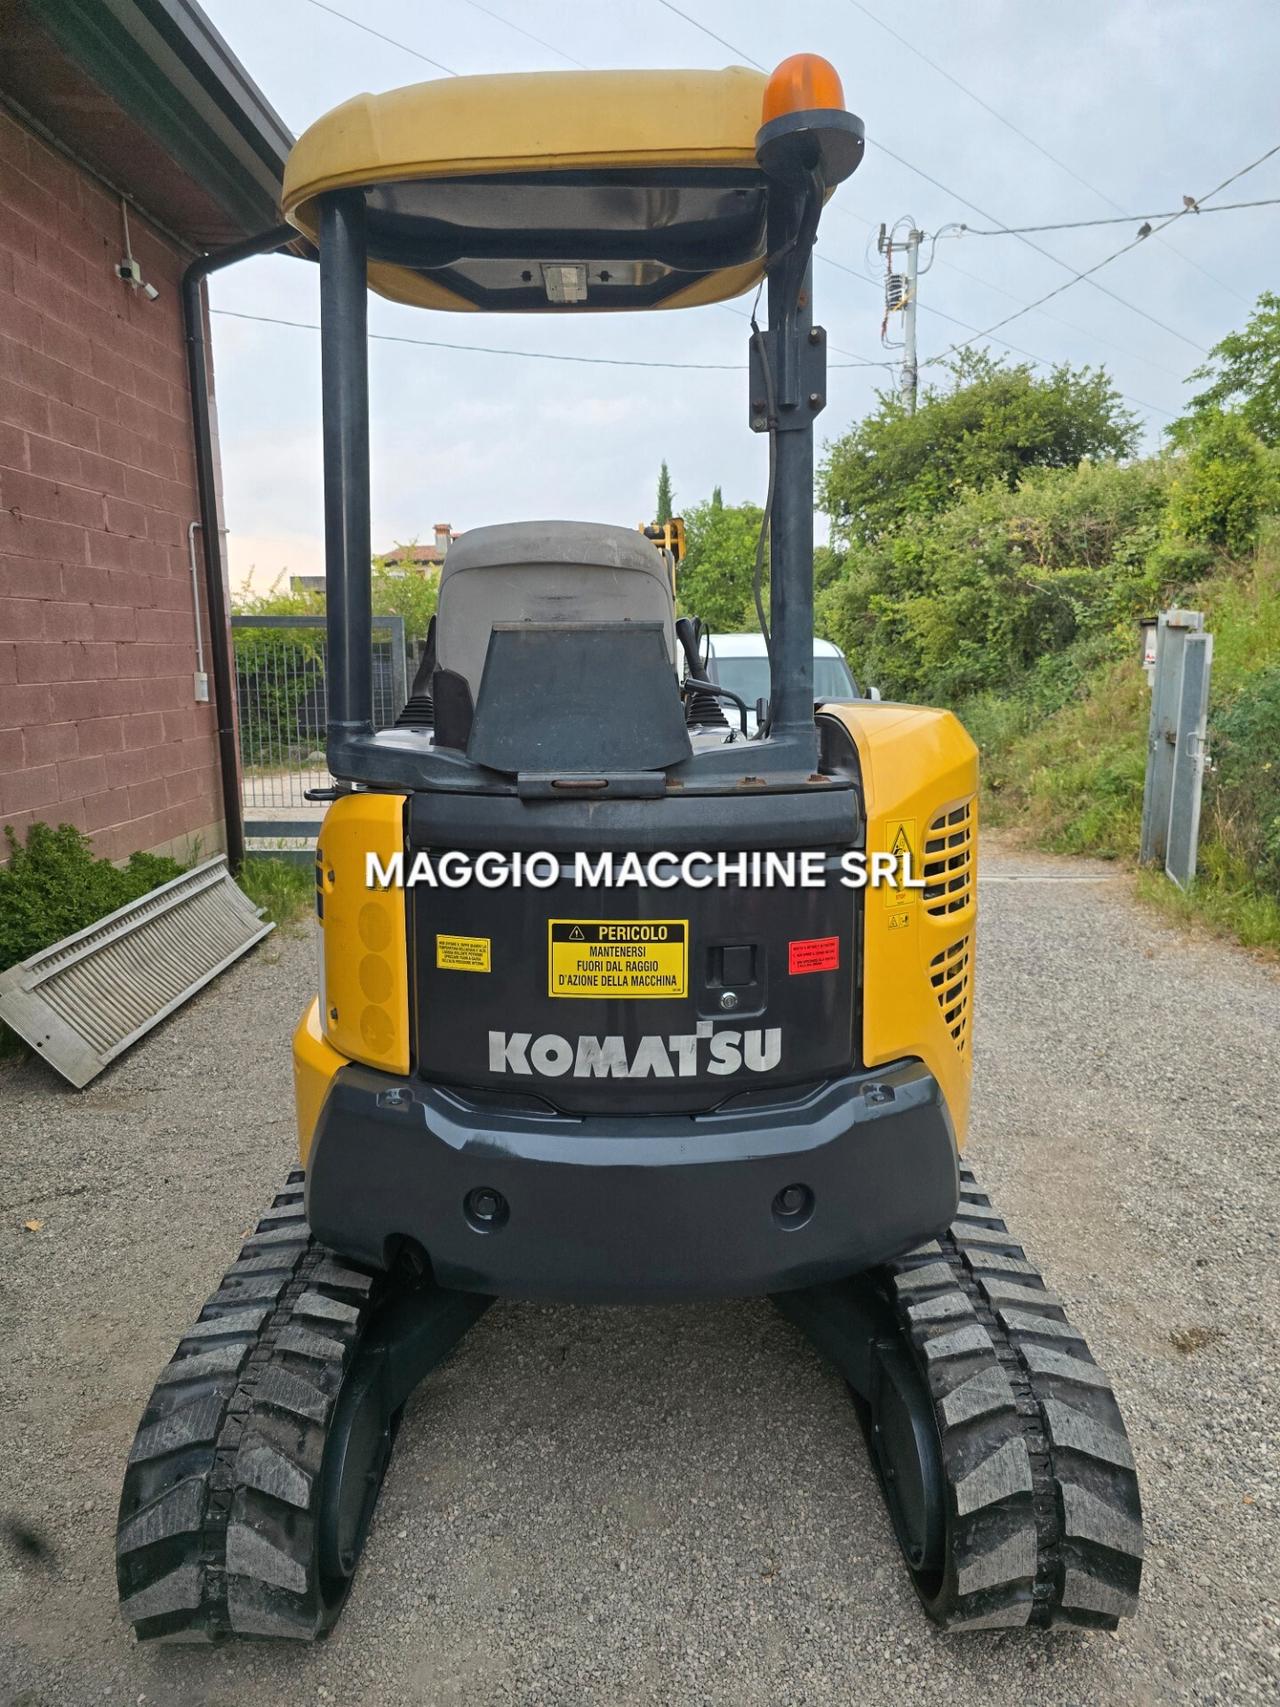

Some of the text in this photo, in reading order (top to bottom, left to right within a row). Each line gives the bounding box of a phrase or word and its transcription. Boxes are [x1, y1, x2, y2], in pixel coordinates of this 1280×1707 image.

[598, 926, 668, 941] PERICOLO
[589, 945, 646, 958] MANTENERSI
[577, 960, 659, 972] FUORI DAL RAGGIO
[558, 974, 677, 987] D'AZIONE DELLA MACCHINA
[488, 1021, 782, 1078] KOMATSU
